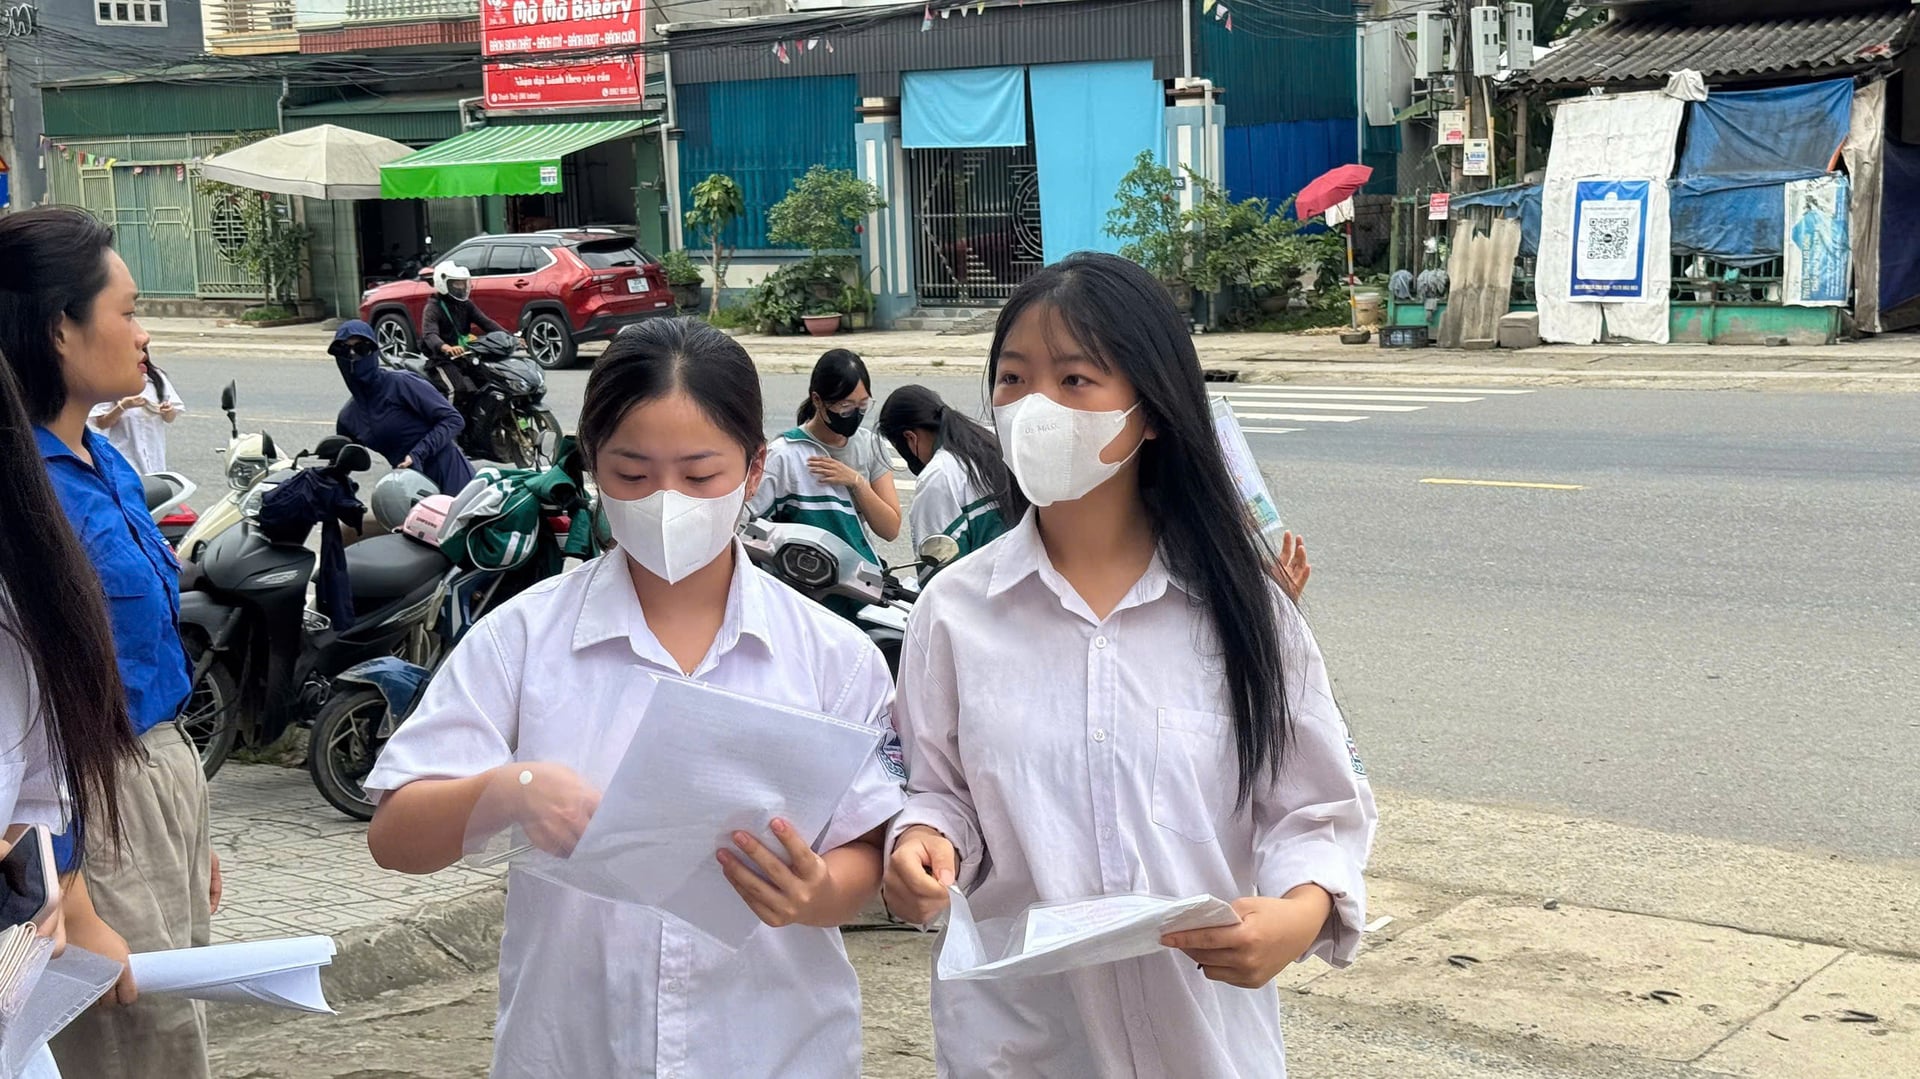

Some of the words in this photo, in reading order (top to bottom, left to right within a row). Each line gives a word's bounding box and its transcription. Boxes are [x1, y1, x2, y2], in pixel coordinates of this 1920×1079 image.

[572, 0, 632, 24] Bakery
[490, 37, 504, 52] BÁNH
[537, 34, 552, 49] BÁNH
[568, 32, 583, 47] BÁNH
[604, 29, 620, 45] BÁNH
[565, 72, 581, 84] theo
